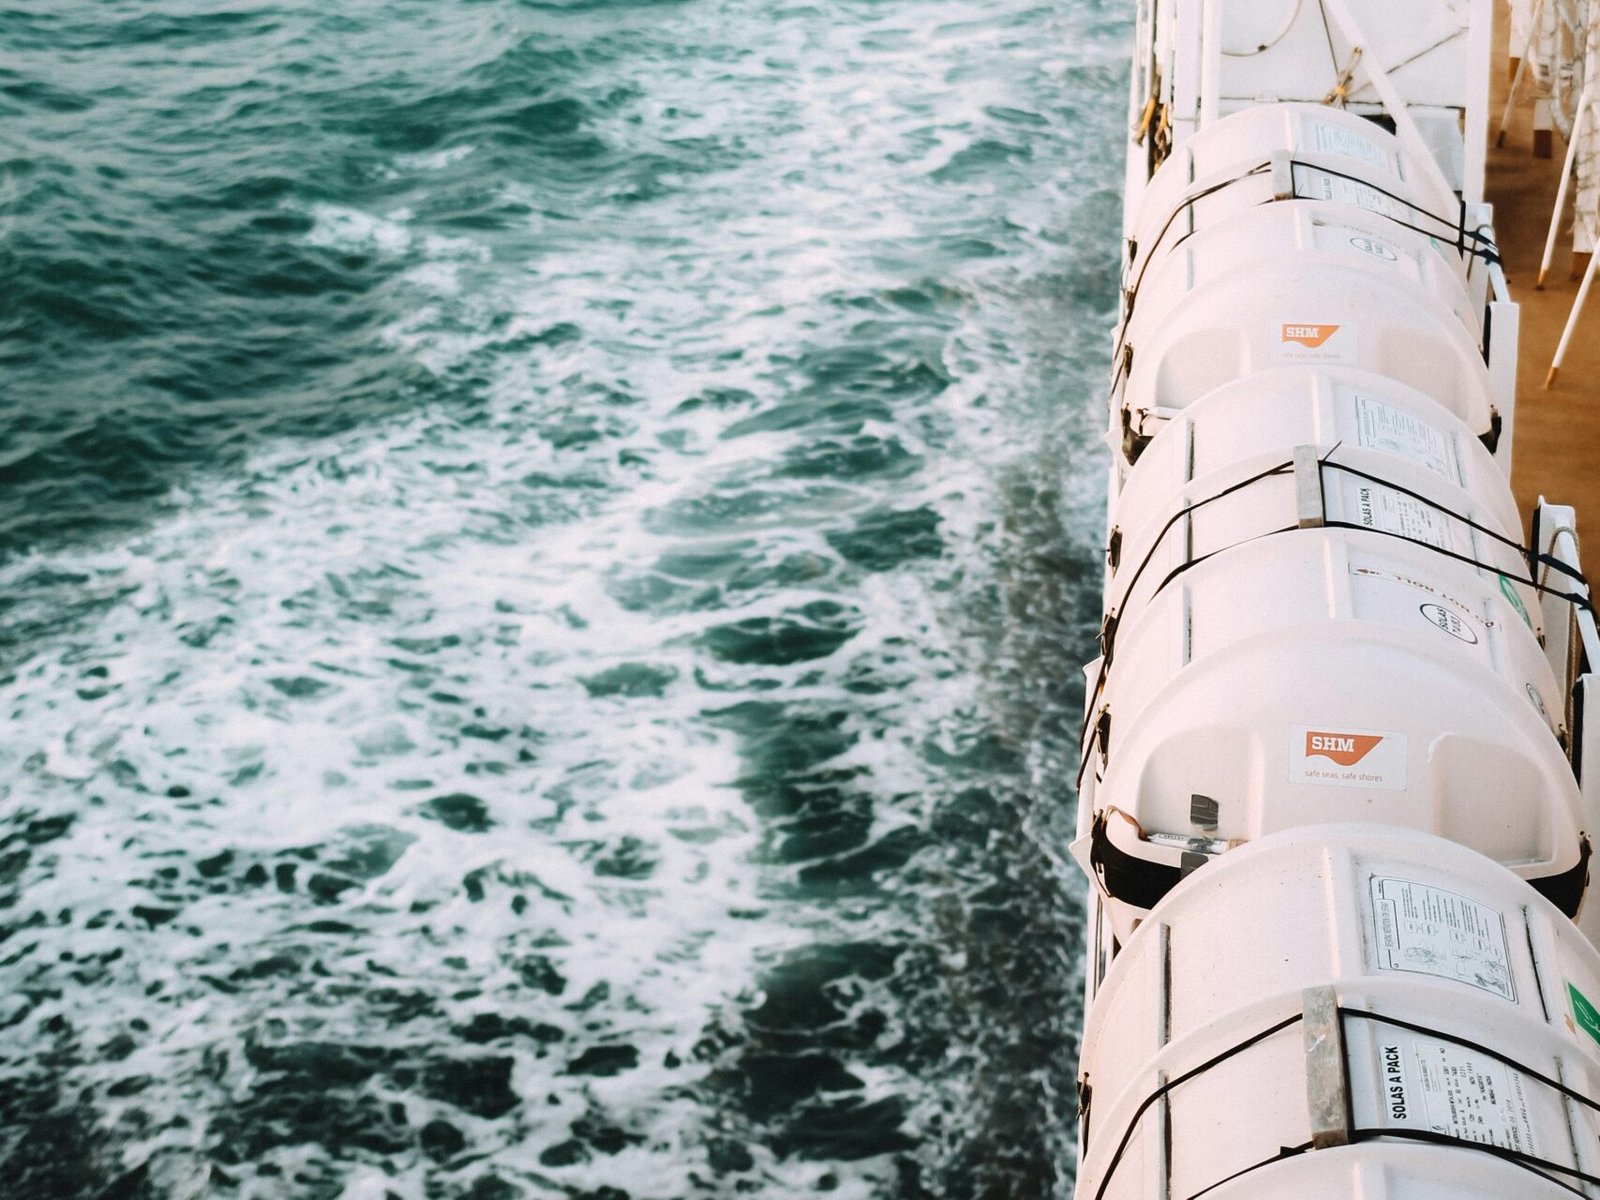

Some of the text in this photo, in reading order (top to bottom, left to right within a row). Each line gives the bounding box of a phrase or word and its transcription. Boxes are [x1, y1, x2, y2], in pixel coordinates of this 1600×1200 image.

[1286, 327, 1320, 338] SHM
[1360, 488, 1372, 503] PACK
[1364, 508, 1373, 526] SOLAS
[1394, 575, 1434, 592] ROLL
[1437, 607, 1449, 630] SOLAS
[1311, 736, 1355, 753] SHM
[1304, 769, 1321, 778] safe
[1342, 771, 1357, 781] safe
[1359, 773, 1383, 782] shores
[1385, 1046, 1401, 1073] PACK
[1390, 1086, 1407, 1120] SOLAS
